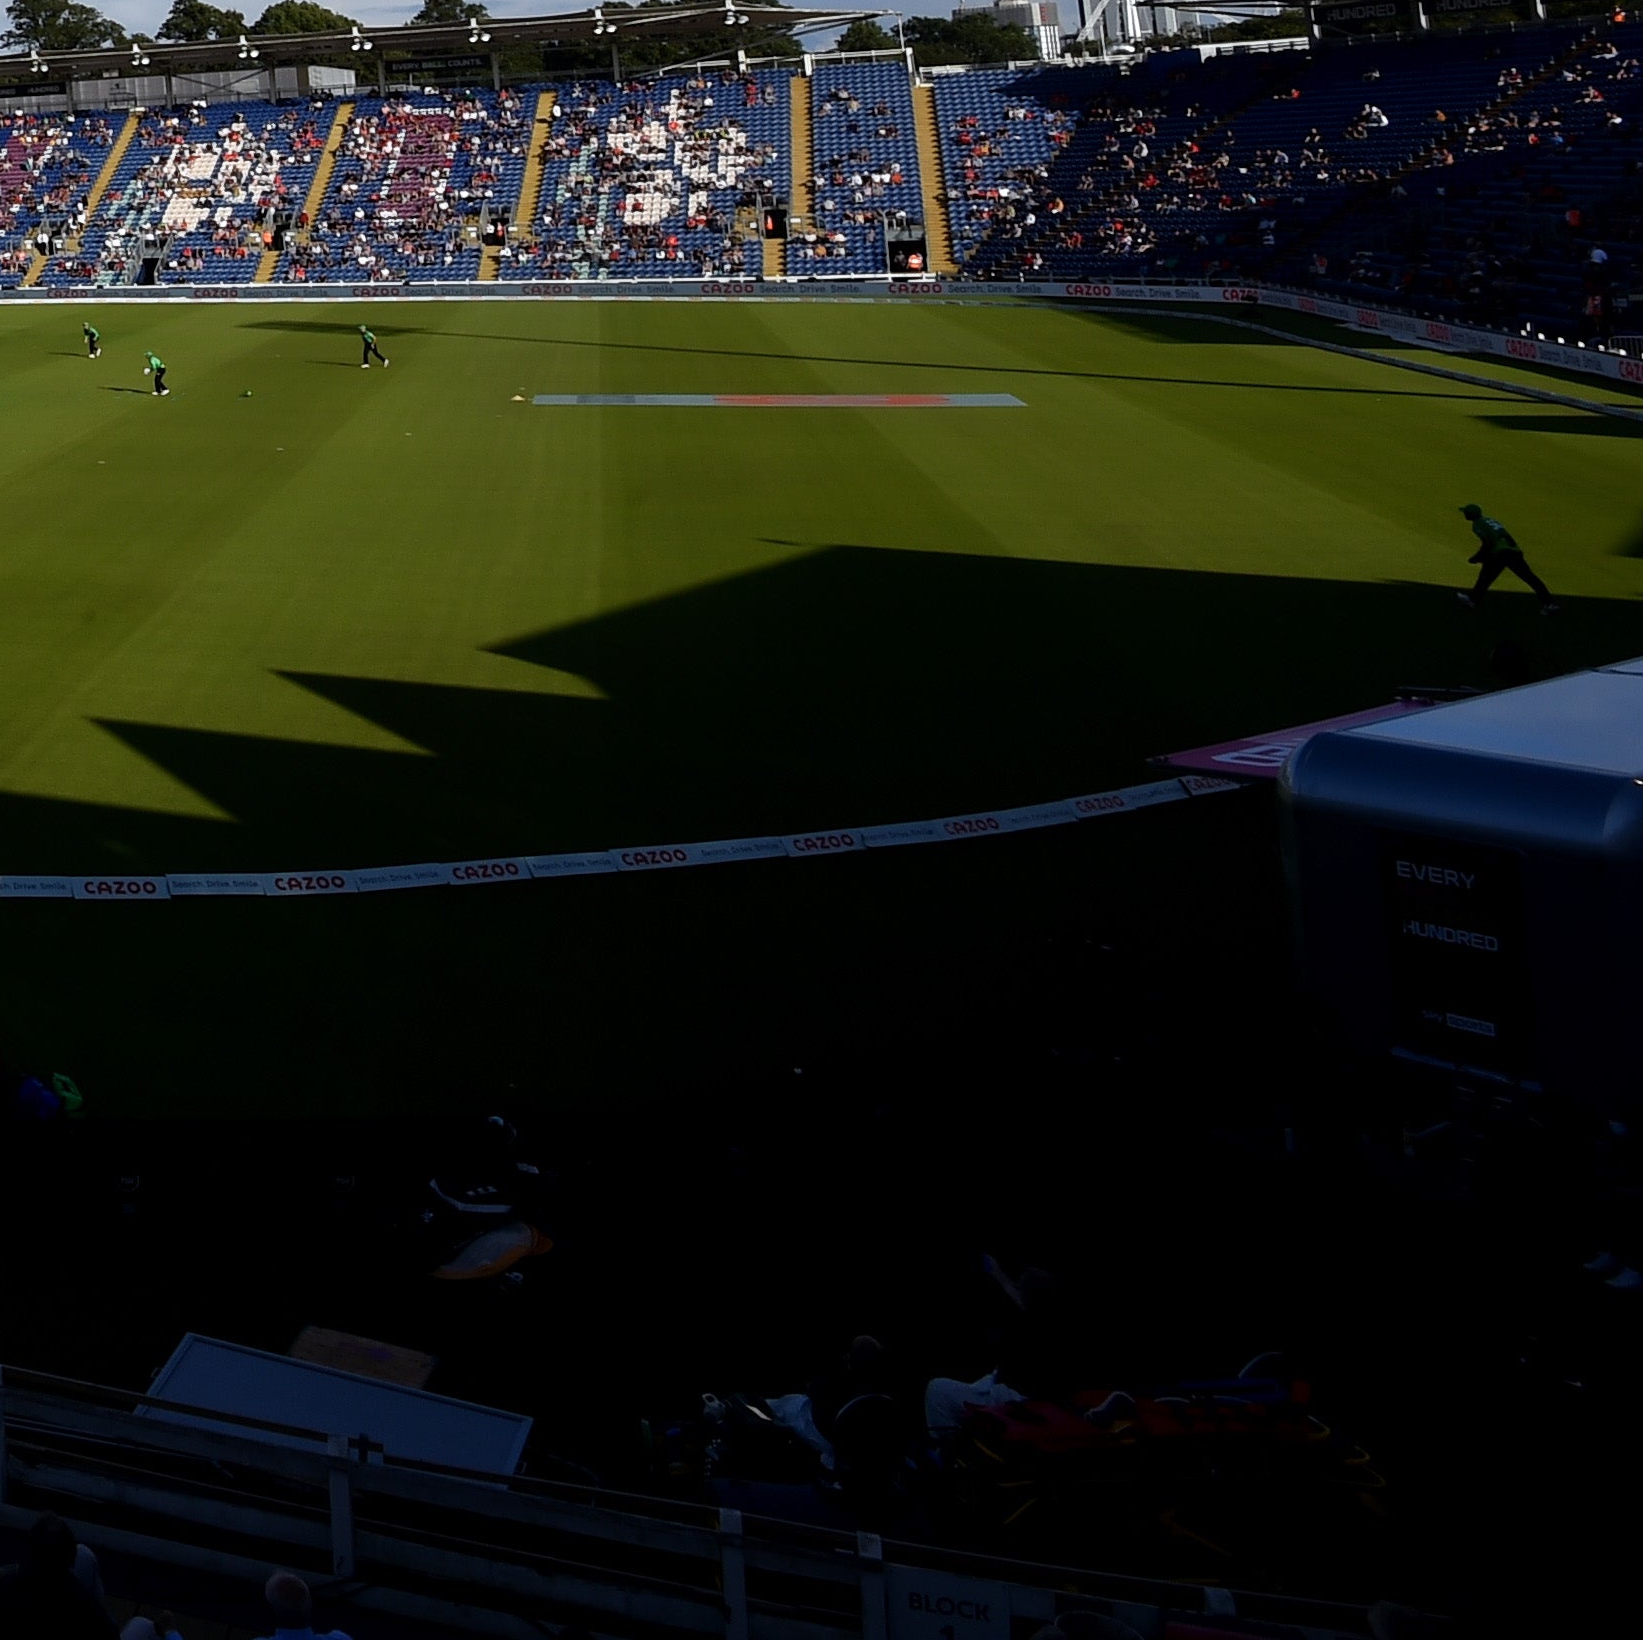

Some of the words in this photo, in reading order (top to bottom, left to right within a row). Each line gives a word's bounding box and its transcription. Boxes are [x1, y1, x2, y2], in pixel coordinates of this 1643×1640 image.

[1326, 3, 1396, 22] HUNDRED
[353, 286, 400, 297] CAZOO
[522, 284, 572, 296] CAZOO
[701, 283, 754, 294] CAZOO
[888, 283, 943, 294] CAZOO
[1066, 284, 1112, 297] CAZOO
[944, 817, 1000, 837] CAZOO
[793, 834, 855, 852] CAZOO
[620, 849, 687, 867] CAZOO
[452, 863, 519, 880] CAZOO
[1395, 859, 1477, 890] EVERY
[84, 880, 157, 895] CAZOO
[275, 876, 345, 891] CAZOO
[1402, 919, 1499, 952] HUNDRED
[908, 1591, 991, 1624] BLOCK
